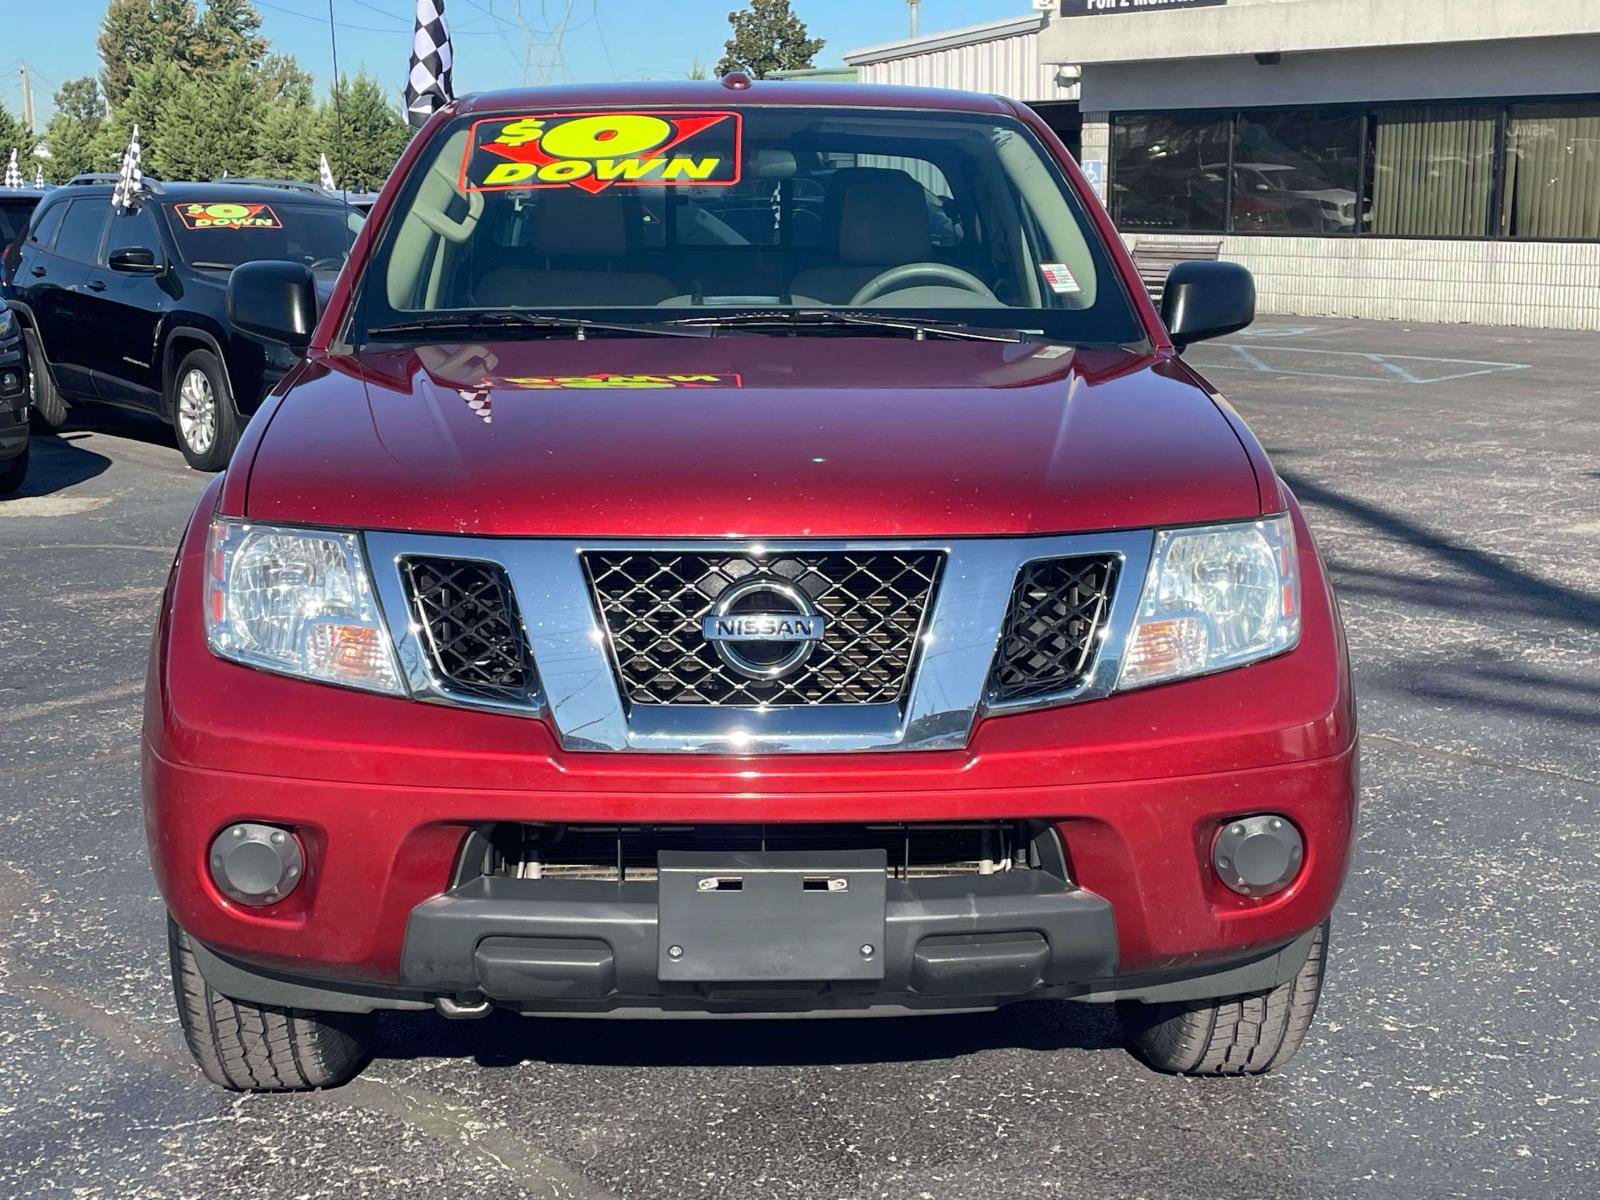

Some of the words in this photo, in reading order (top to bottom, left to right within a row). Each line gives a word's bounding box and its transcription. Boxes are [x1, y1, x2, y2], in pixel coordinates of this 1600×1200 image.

[483, 158, 720, 184] DOWN
[195, 218, 273, 227] DOWN
[717, 619, 814, 636] NISSAN
